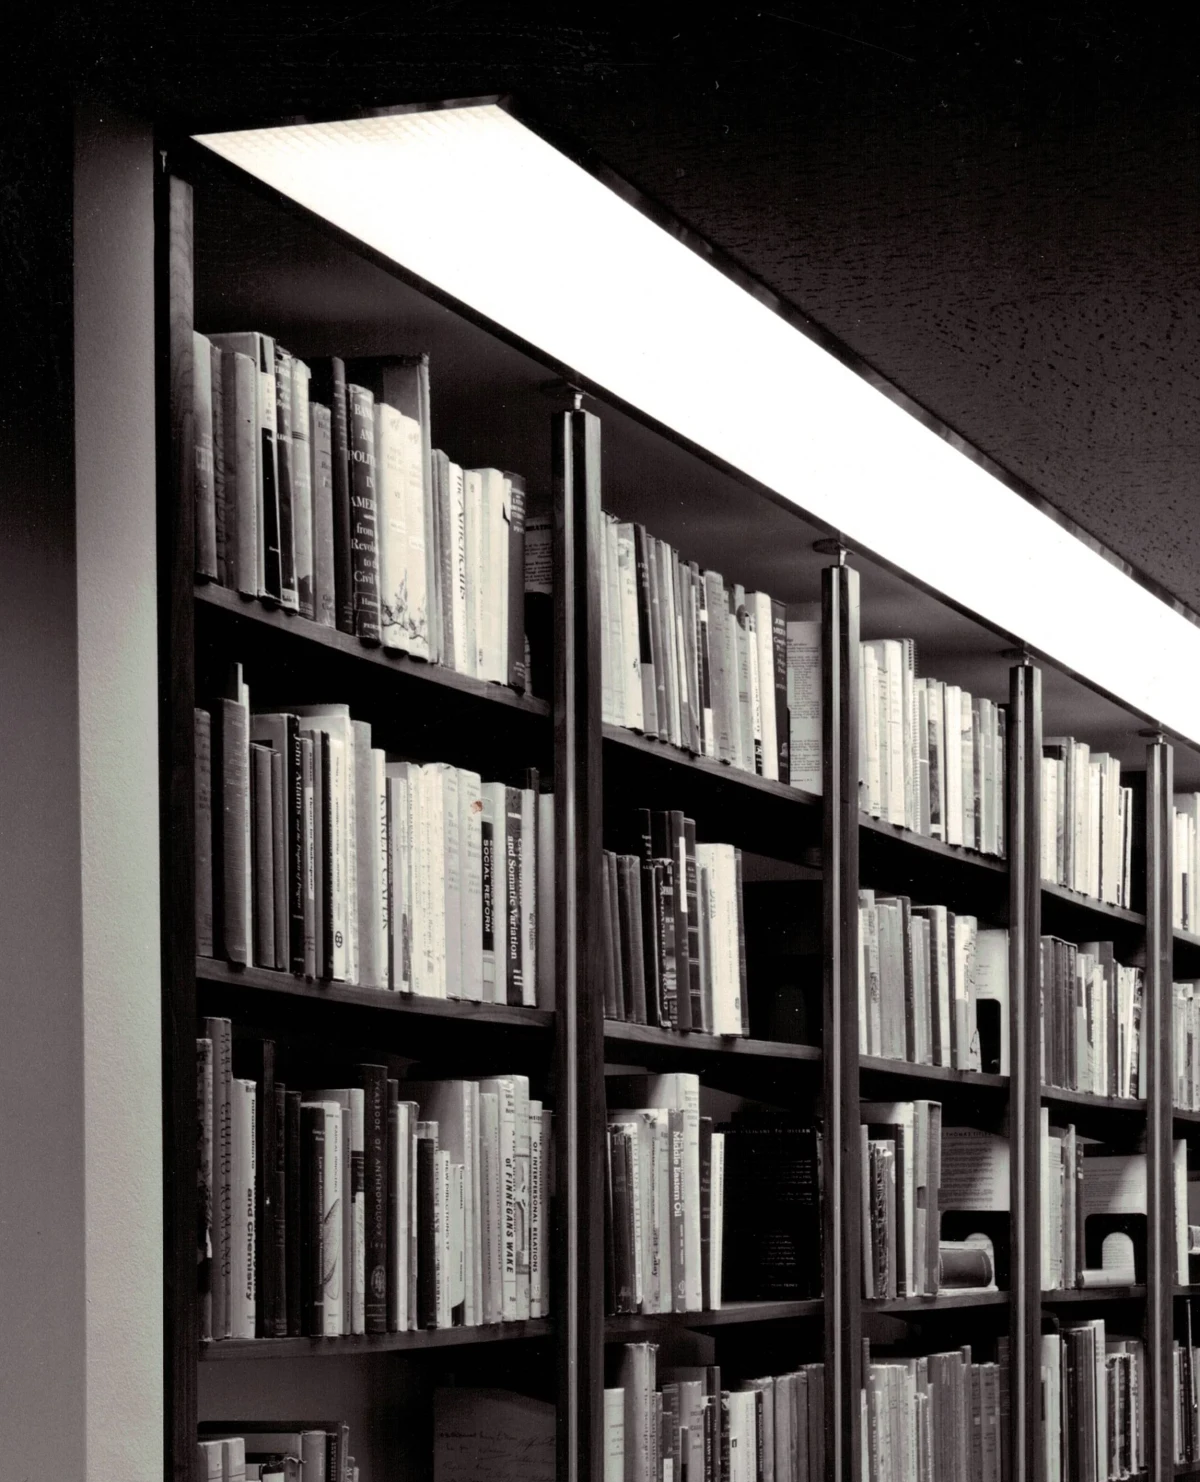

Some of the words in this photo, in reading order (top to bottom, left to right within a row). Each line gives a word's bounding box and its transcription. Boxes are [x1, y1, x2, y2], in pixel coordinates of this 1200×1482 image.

[293, 733, 303, 767] John
[295, 771, 303, 815] Adams
[507, 836, 517, 857] and
[508, 858, 518, 905] Somatic
[509, 908, 519, 959] Variation
[532, 1141, 538, 1153] OF
[673, 1131, 681, 1165] Middle
[374, 1158, 383, 1236] ANTHROPOLOGY
[673, 1167, 682, 1201] Eastern
[505, 1172, 514, 1238] FINNEGANS
[673, 1202, 682, 1217] Oil
[506, 1242, 514, 1273] WAKE
